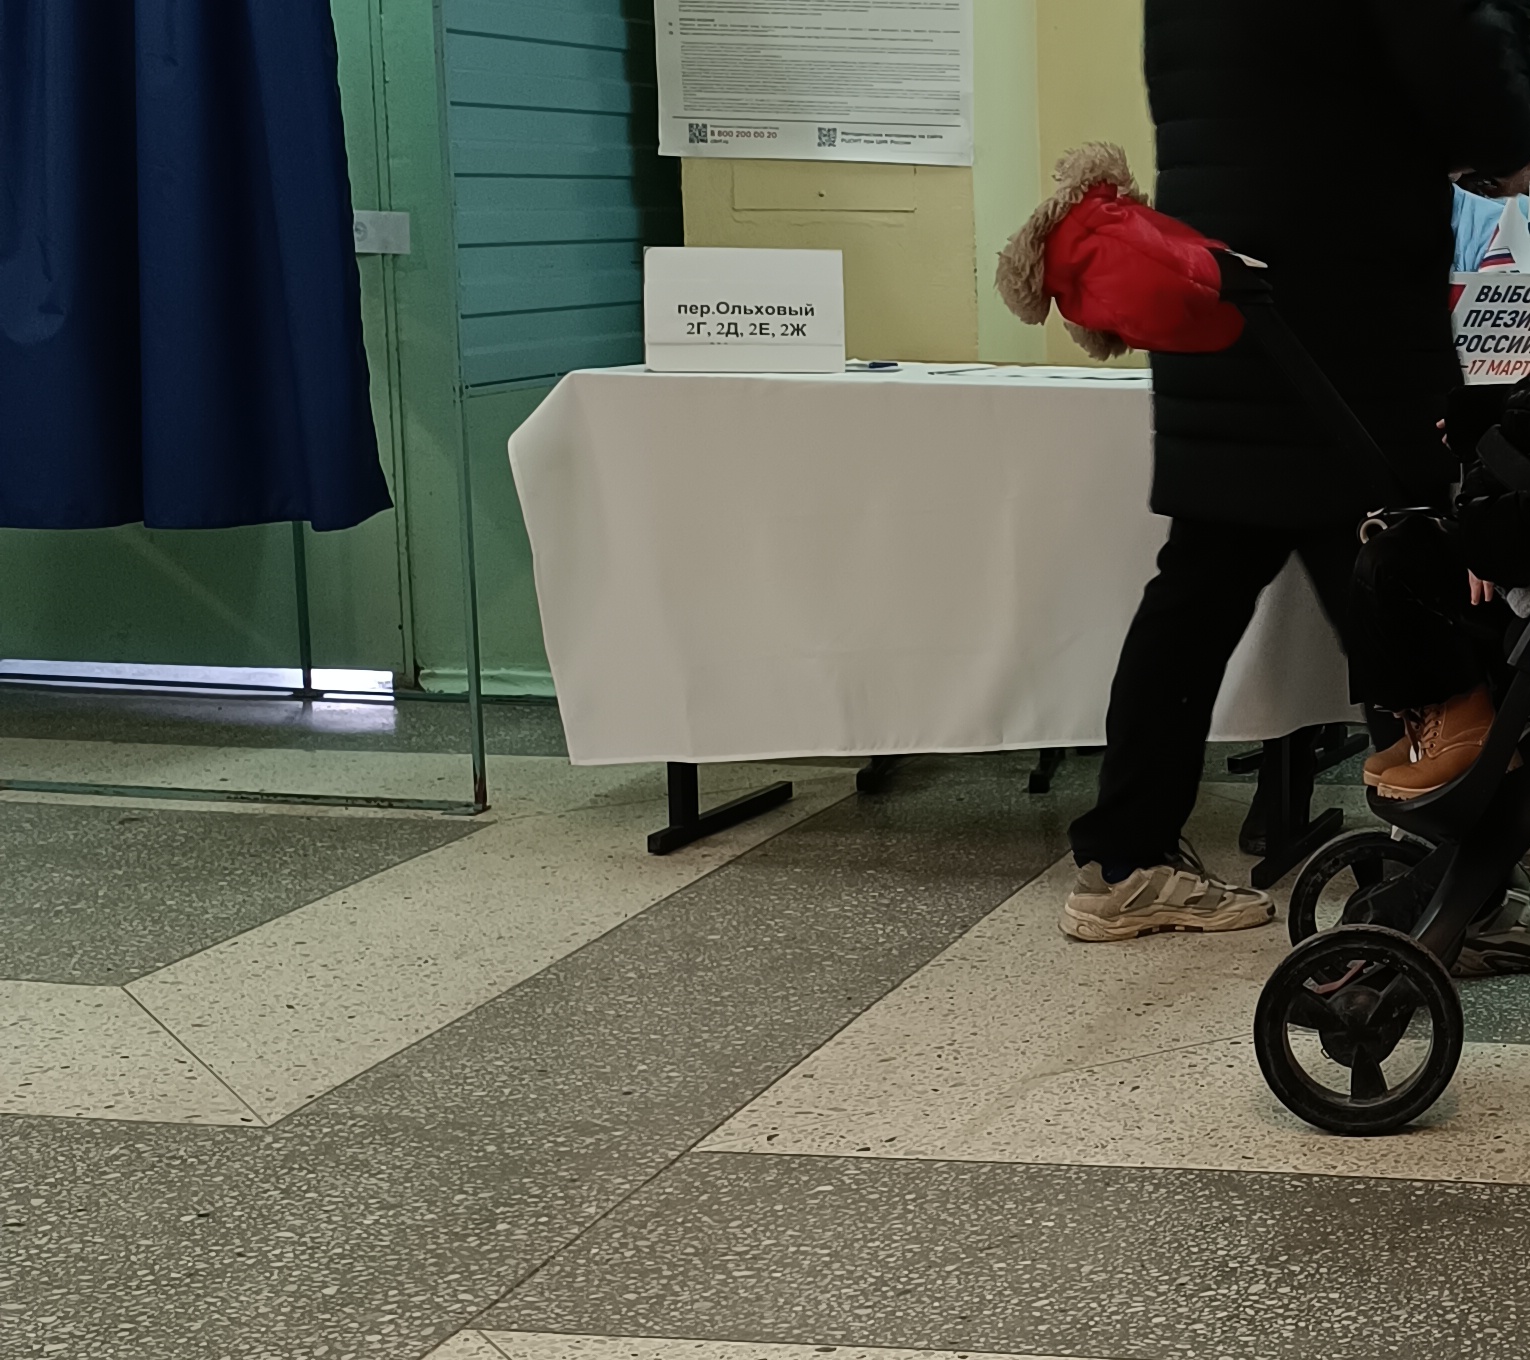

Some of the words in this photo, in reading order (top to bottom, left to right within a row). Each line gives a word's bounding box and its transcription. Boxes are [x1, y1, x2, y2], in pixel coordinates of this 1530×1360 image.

[736, 130, 752, 138] 200
[766, 131, 778, 139] 20
[677, 301, 815, 317] пер.Ольховый
[686, 322, 711, 337] 2Г,
[716, 322, 744, 338] 2Д,
[749, 322, 776, 338] 2Е,
[780, 323, 807, 337] 2Ж
